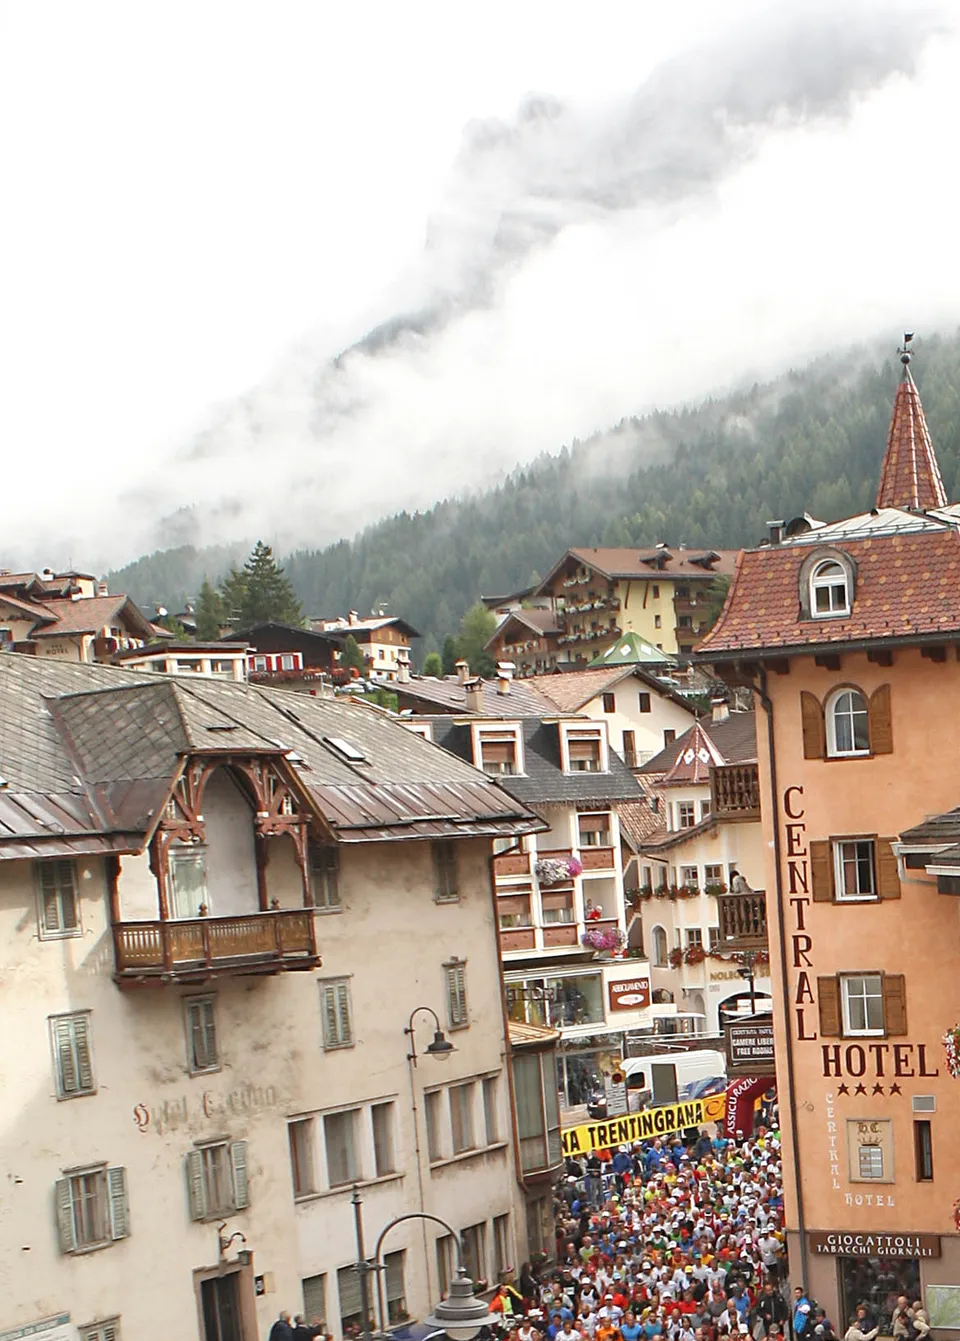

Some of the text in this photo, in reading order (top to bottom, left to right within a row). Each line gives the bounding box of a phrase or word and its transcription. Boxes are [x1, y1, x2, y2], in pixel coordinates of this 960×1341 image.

[783, 785, 818, 1041] CENTRAL
[821, 1043, 940, 1078] HOTEL
[588, 1102, 704, 1148] TRENTINGRANA
[816, 1244, 933, 1257] TABACCHI GIORNALI
[827, 1234, 921, 1248] GIOCATTOLI
